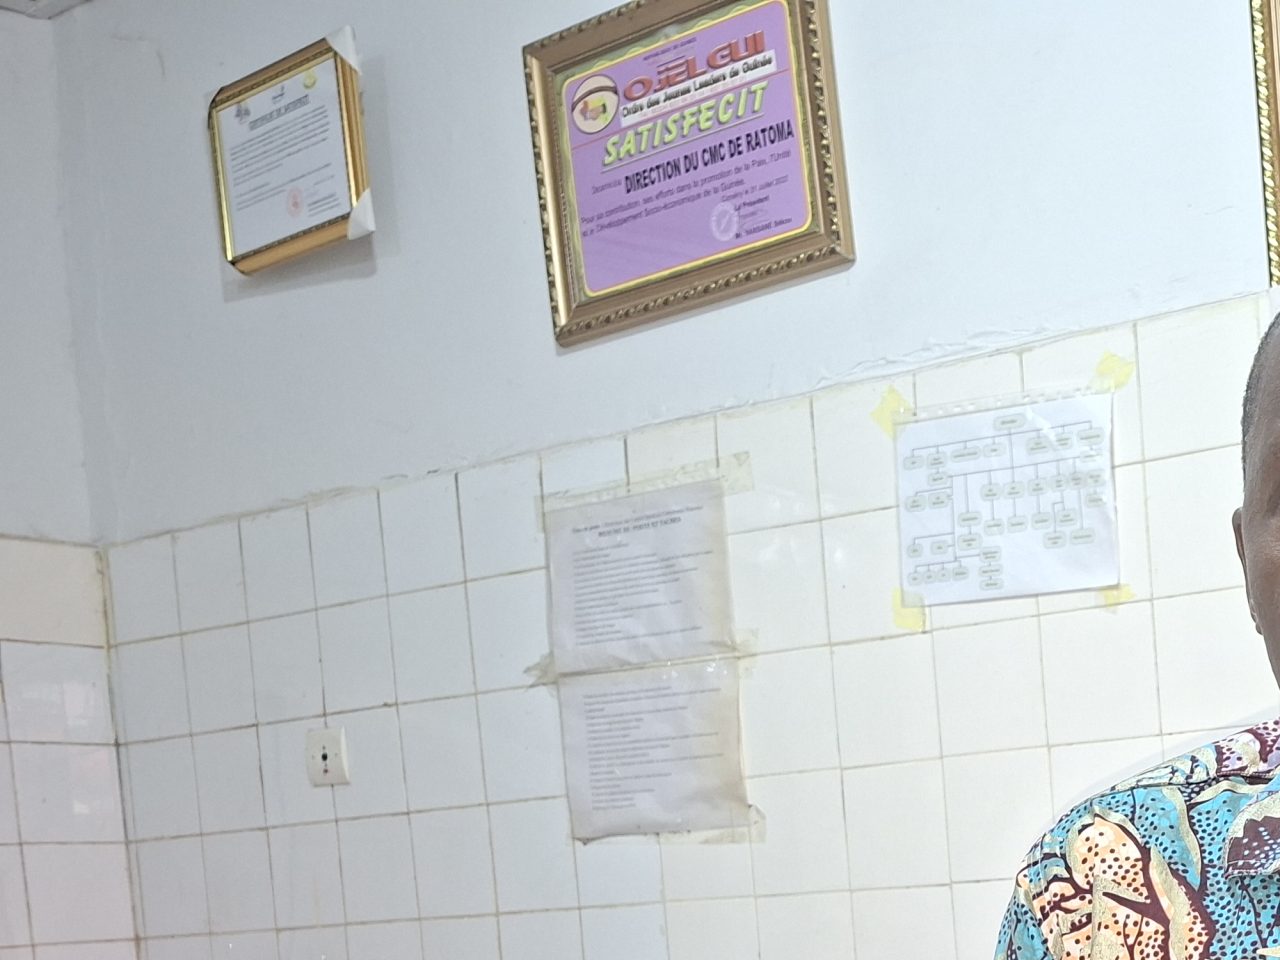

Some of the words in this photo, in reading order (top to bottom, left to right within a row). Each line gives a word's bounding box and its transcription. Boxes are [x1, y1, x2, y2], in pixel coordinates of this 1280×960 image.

[602, 80, 769, 166] SATISFECIT
[624, 156, 682, 194] DIRECTION
[684, 150, 700, 175] DU
[702, 144, 726, 168] CMC
[728, 138, 744, 159] DE
[745, 119, 795, 153] RATOMA
